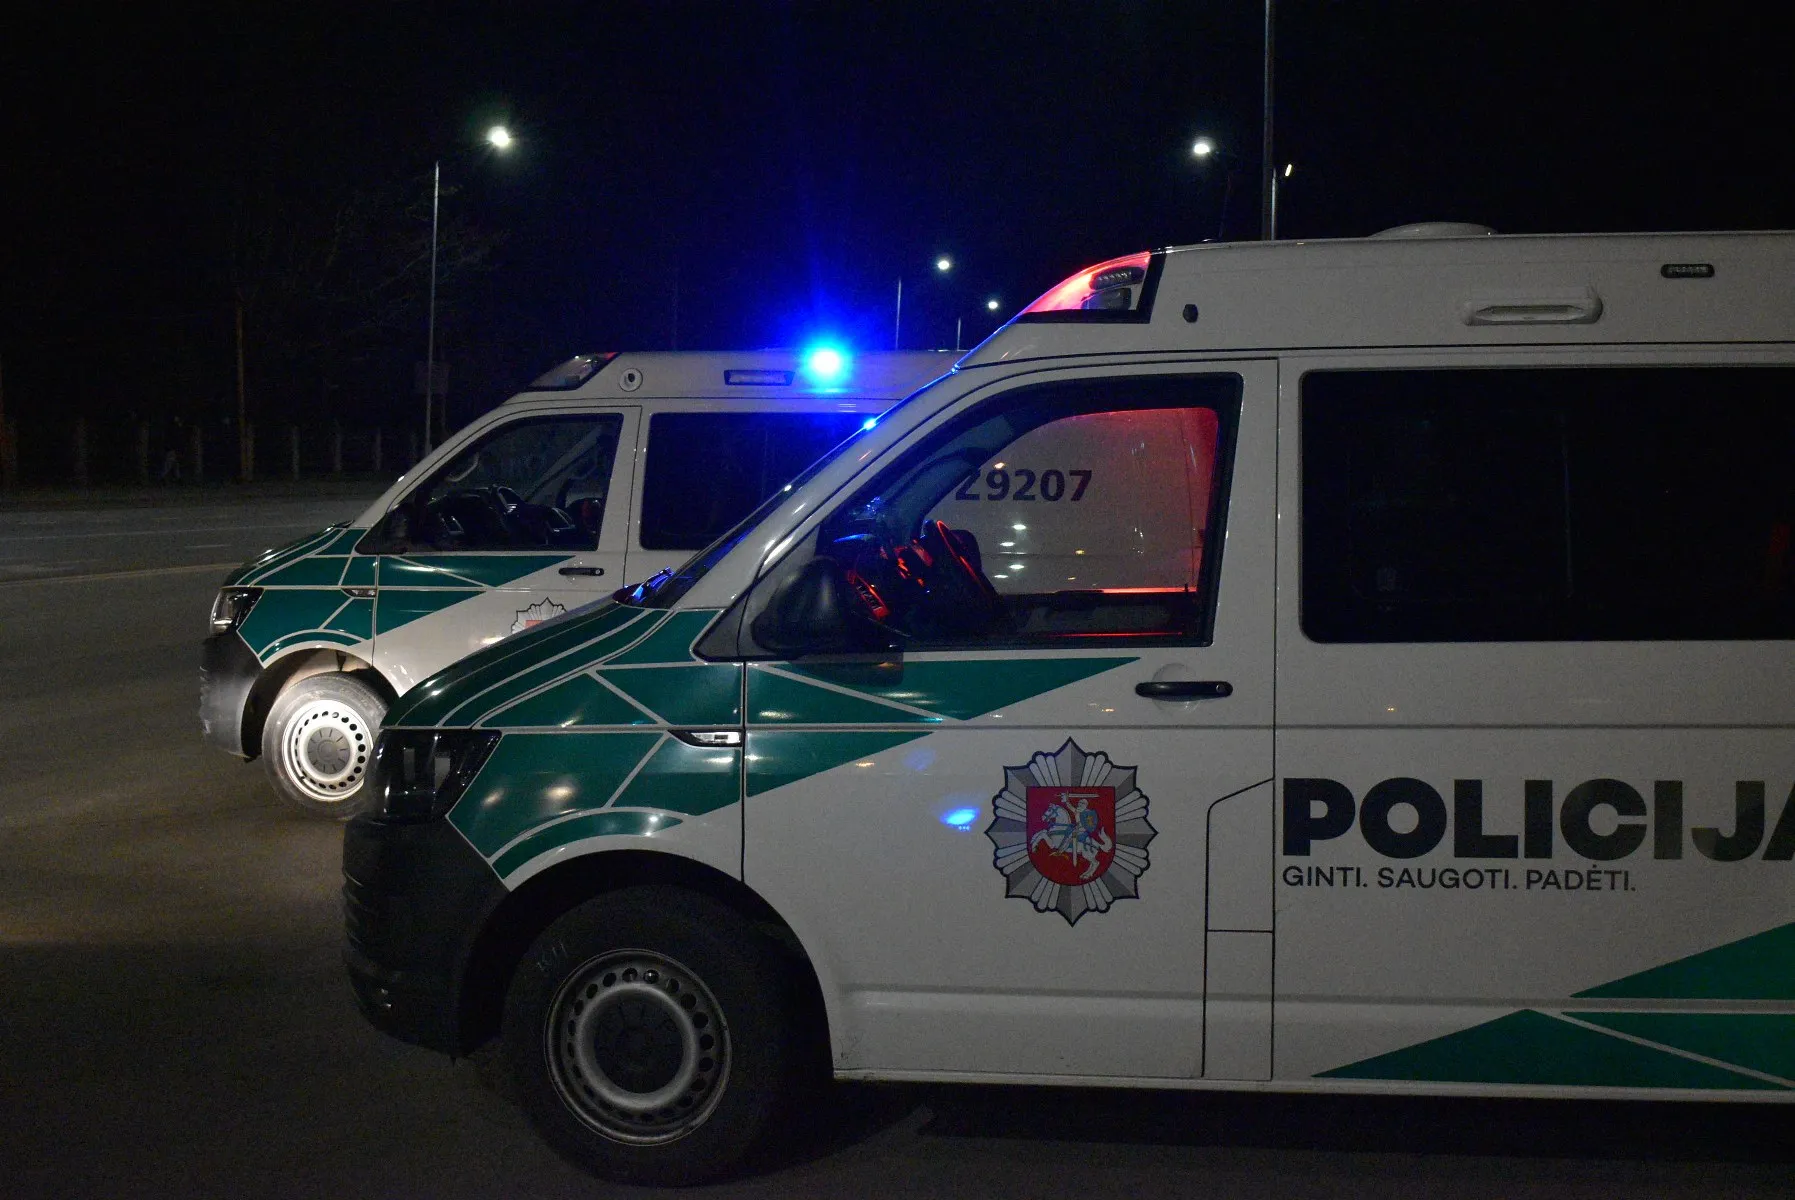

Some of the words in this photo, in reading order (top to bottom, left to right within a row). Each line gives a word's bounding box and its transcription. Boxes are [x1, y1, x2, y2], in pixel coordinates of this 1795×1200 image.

[1282, 865, 1368, 888] GINTI.
[1377, 866, 1517, 890] SAUGOTI.
[1525, 864, 1636, 892] PADĖTI.
